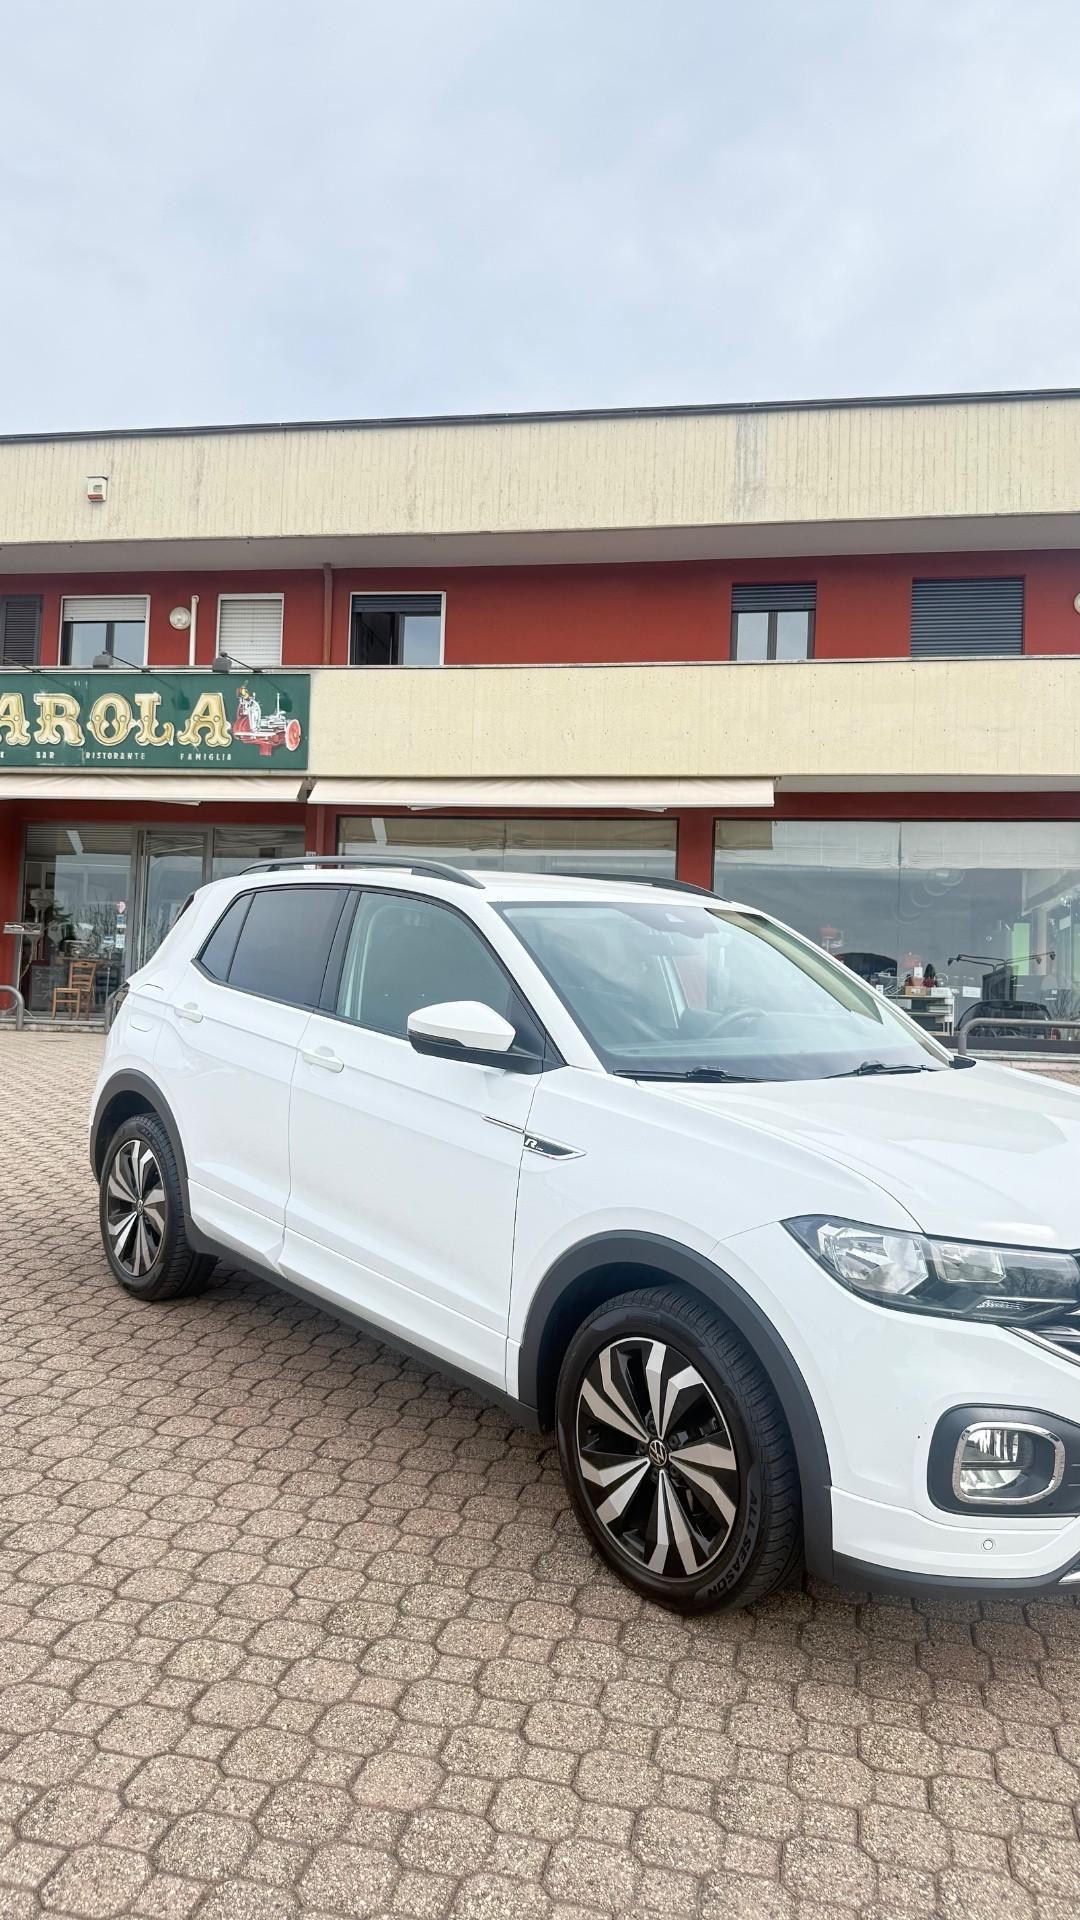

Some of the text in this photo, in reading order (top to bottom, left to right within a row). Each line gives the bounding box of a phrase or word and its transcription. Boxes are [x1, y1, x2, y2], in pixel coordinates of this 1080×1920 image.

[0, 693, 232, 747] AROLA
[85, 752, 146, 760] RISTORANTE
[180, 753, 232, 761] FAMIGLIA
[707, 1489, 758, 1597] ALL SEASON
